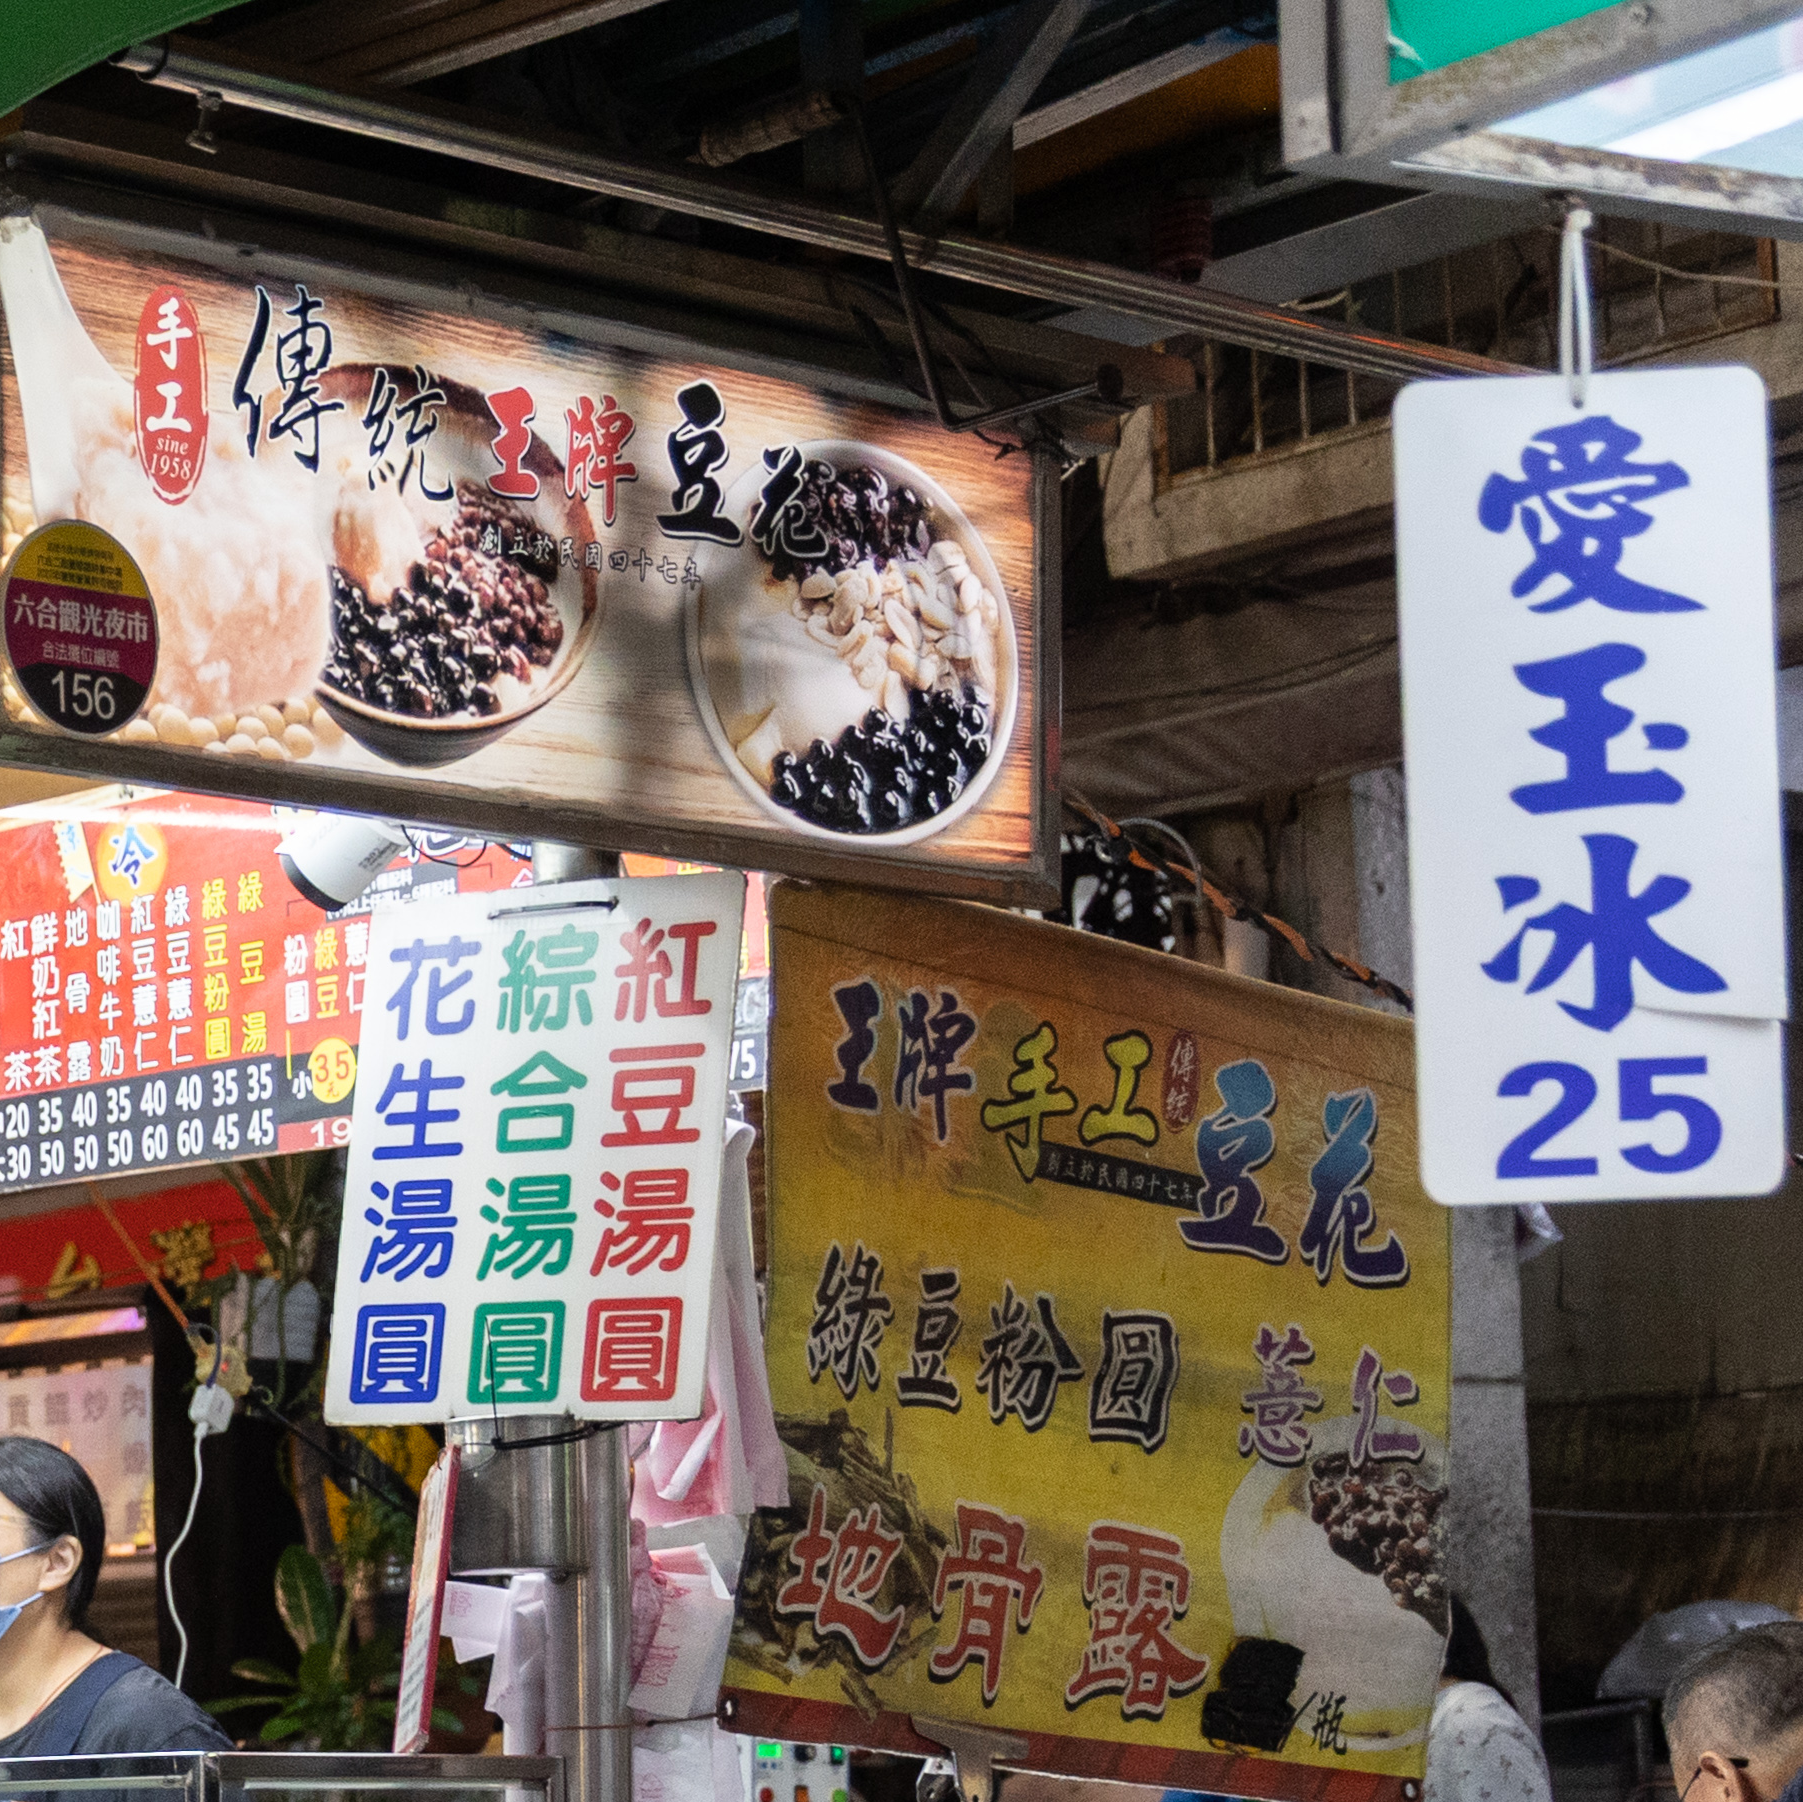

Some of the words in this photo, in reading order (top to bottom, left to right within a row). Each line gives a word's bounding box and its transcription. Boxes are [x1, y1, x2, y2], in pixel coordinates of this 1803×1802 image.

[146, 295, 194, 434] 手工
[233, 284, 829, 558] 傳統王牌豆花
[150, 454, 192, 478] 1958
[51, 668, 116, 720] 156
[1478, 414, 1729, 1033] 愛玉冰
[108, 824, 157, 886] 冷
[30, 911, 63, 1087] 鮮奶紅茶
[64, 906, 92, 1083] 地骨露
[95, 899, 125, 1077] 咖啡牛奶
[130, 893, 160, 1072] 紅豆薏仁
[163, 884, 195, 1065] 綠豆薏仁
[201, 877, 232, 1061] 綠豆粉圓
[237, 870, 269, 1054] 綠豆湯
[283, 933, 311, 1025] 粉圓
[313, 926, 341, 1020] 綠豆
[5, 1103, 30, 1140] 20
[38, 1098, 63, 1134] 35
[71, 1091, 97, 1129] 40
[106, 1085, 132, 1123] 35
[140, 1079, 167, 1117] 40
[174, 1074, 203, 1112] 40
[212, 1068, 240, 1106] 35
[246, 1062, 273, 1102] 35
[6, 1144, 32, 1183] 30
[38, 1139, 65, 1177] 50
[73, 1133, 99, 1171] 50
[107, 1128, 133, 1166] 50
[142, 1122, 169, 1161] 60
[177, 1117, 205, 1156] 60
[211, 1112, 240, 1150] 45
[246, 1107, 275, 1147] 45
[315, 1050, 350, 1081] 35
[1496, 1056, 1723, 1180] 25
[348, 934, 483, 1405] 花生湯圓
[466, 923, 600, 1405] 綜合湯圓
[579, 916, 718, 1403] 紅豆湯圓
[806, 1239, 1179, 1452] 綠豆粉圓
[1237, 1323, 1426, 1467] 薏仁
[777, 1482, 1210, 1719] 地骨露
